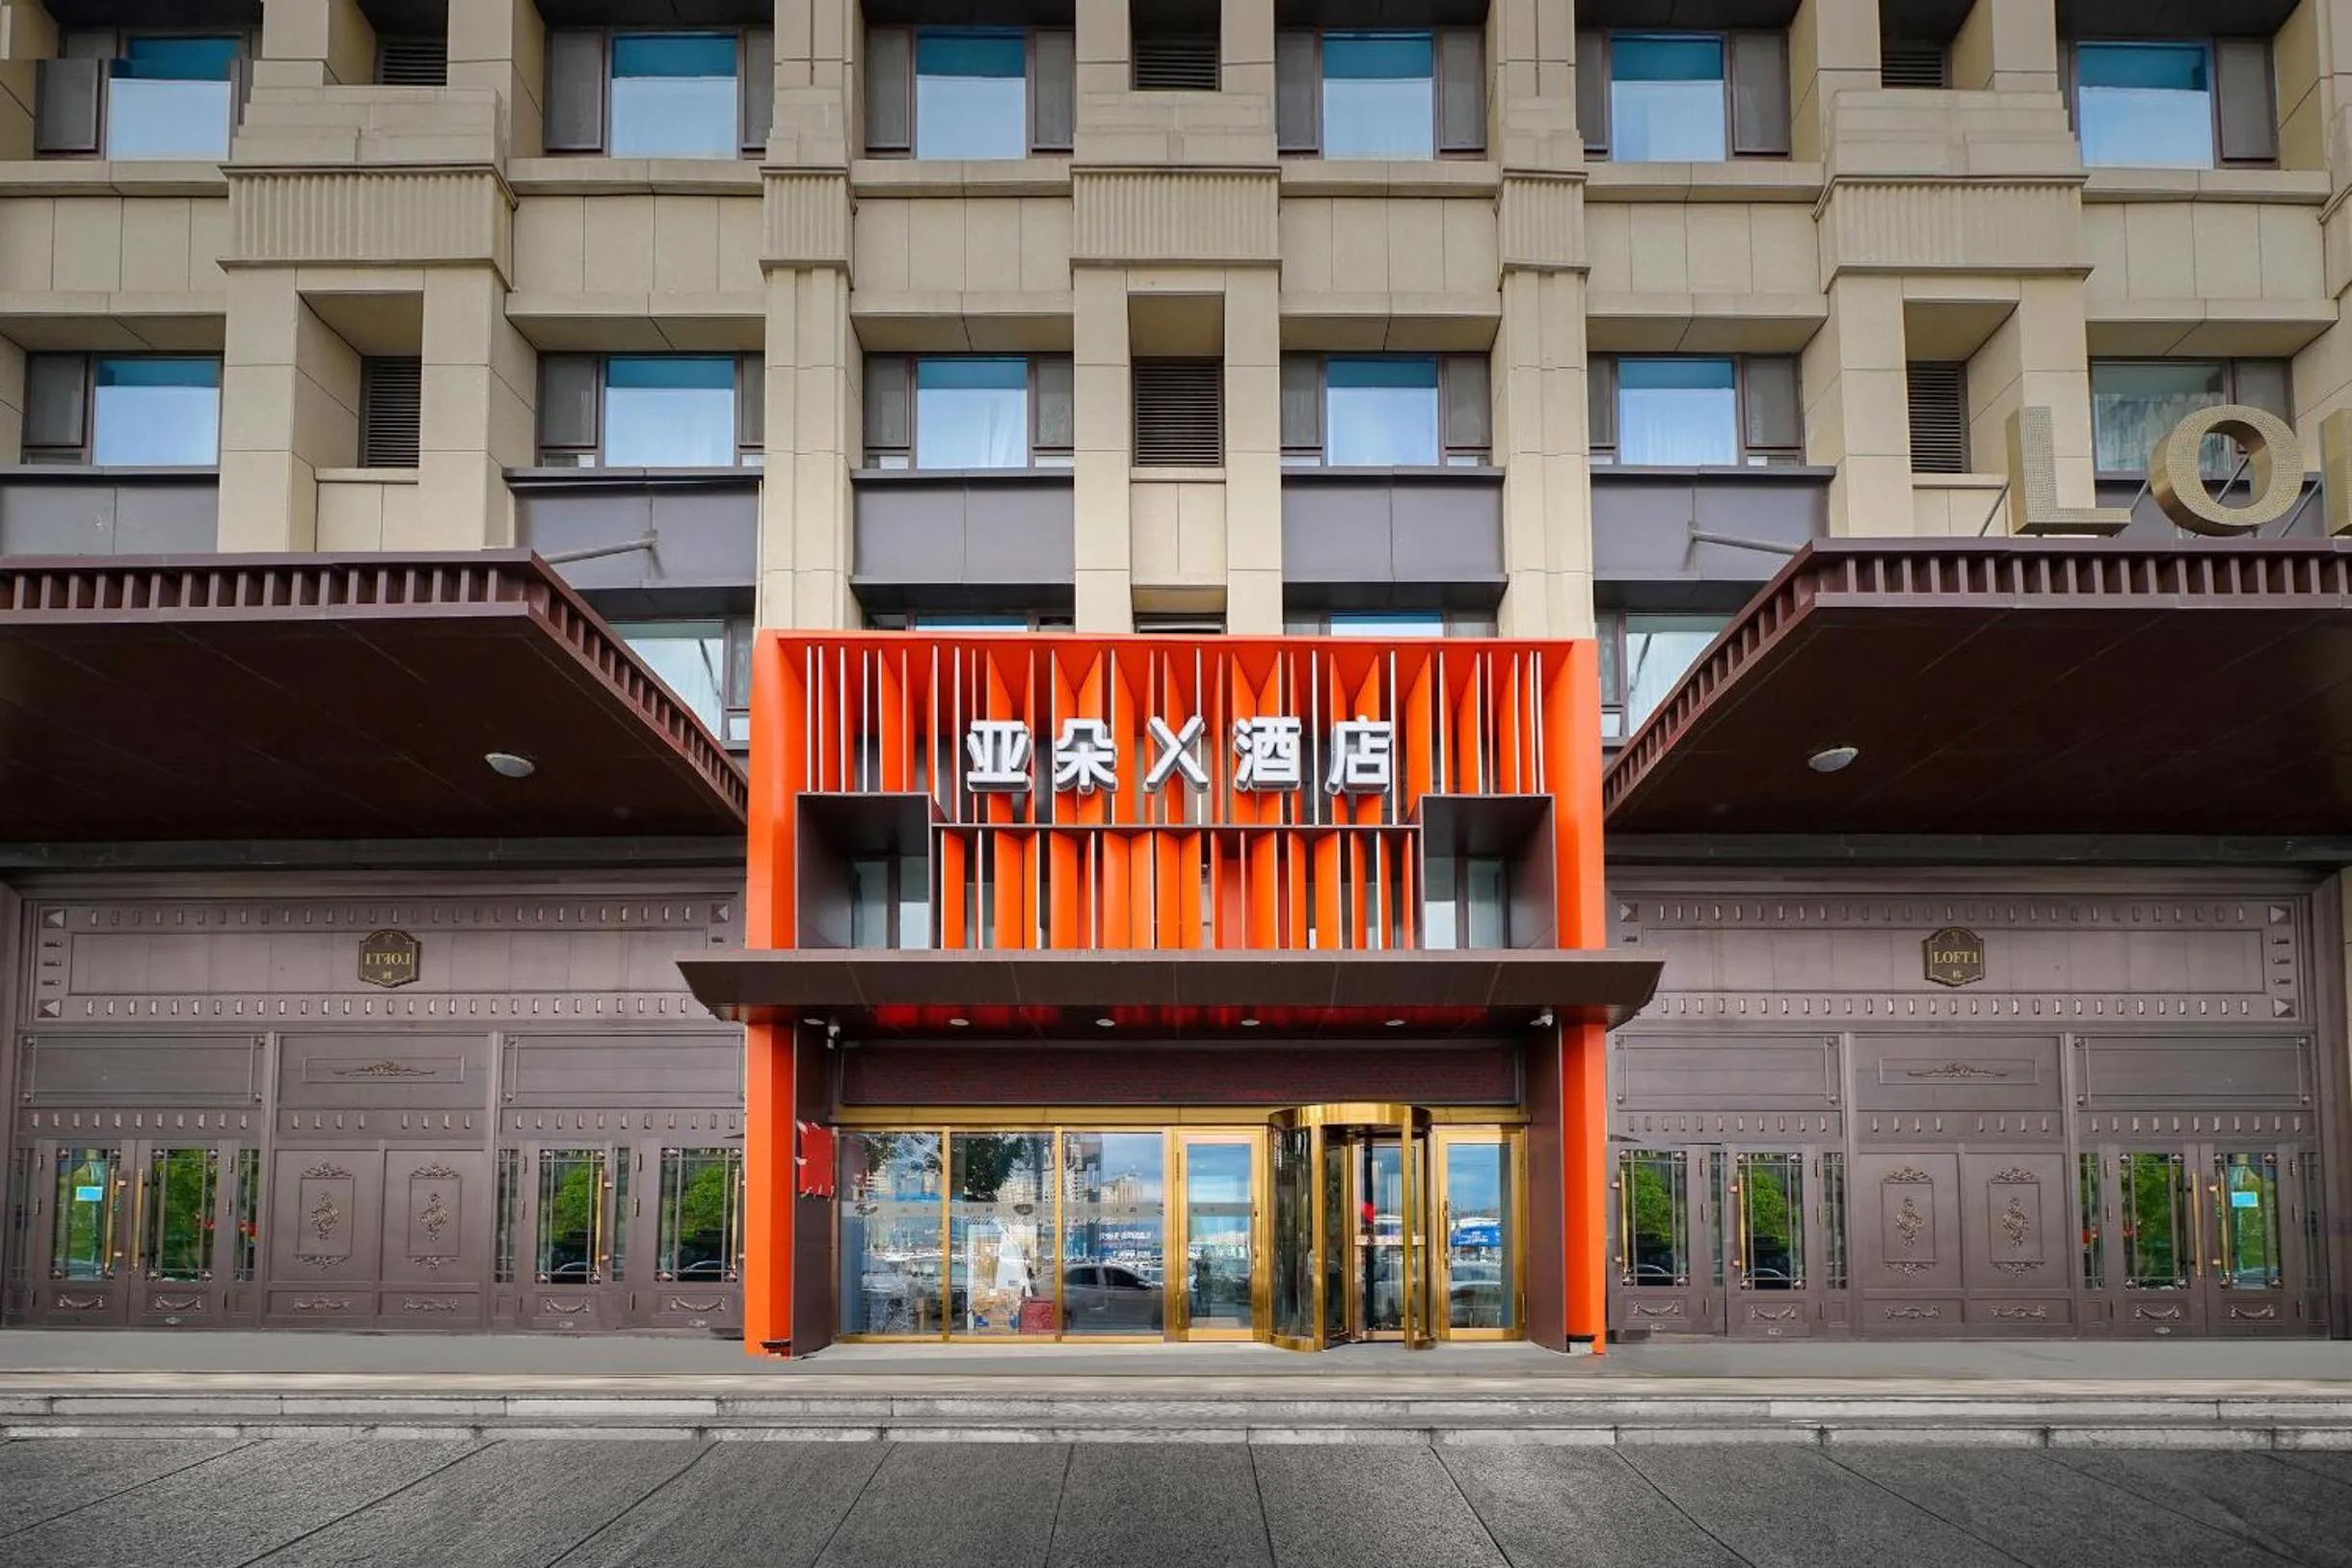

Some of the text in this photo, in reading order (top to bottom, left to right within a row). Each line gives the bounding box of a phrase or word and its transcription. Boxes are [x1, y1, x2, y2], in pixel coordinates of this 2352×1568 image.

[2006, 404, 2352, 537] LO
[967, 715, 1392, 793] 亚朵X酒店
